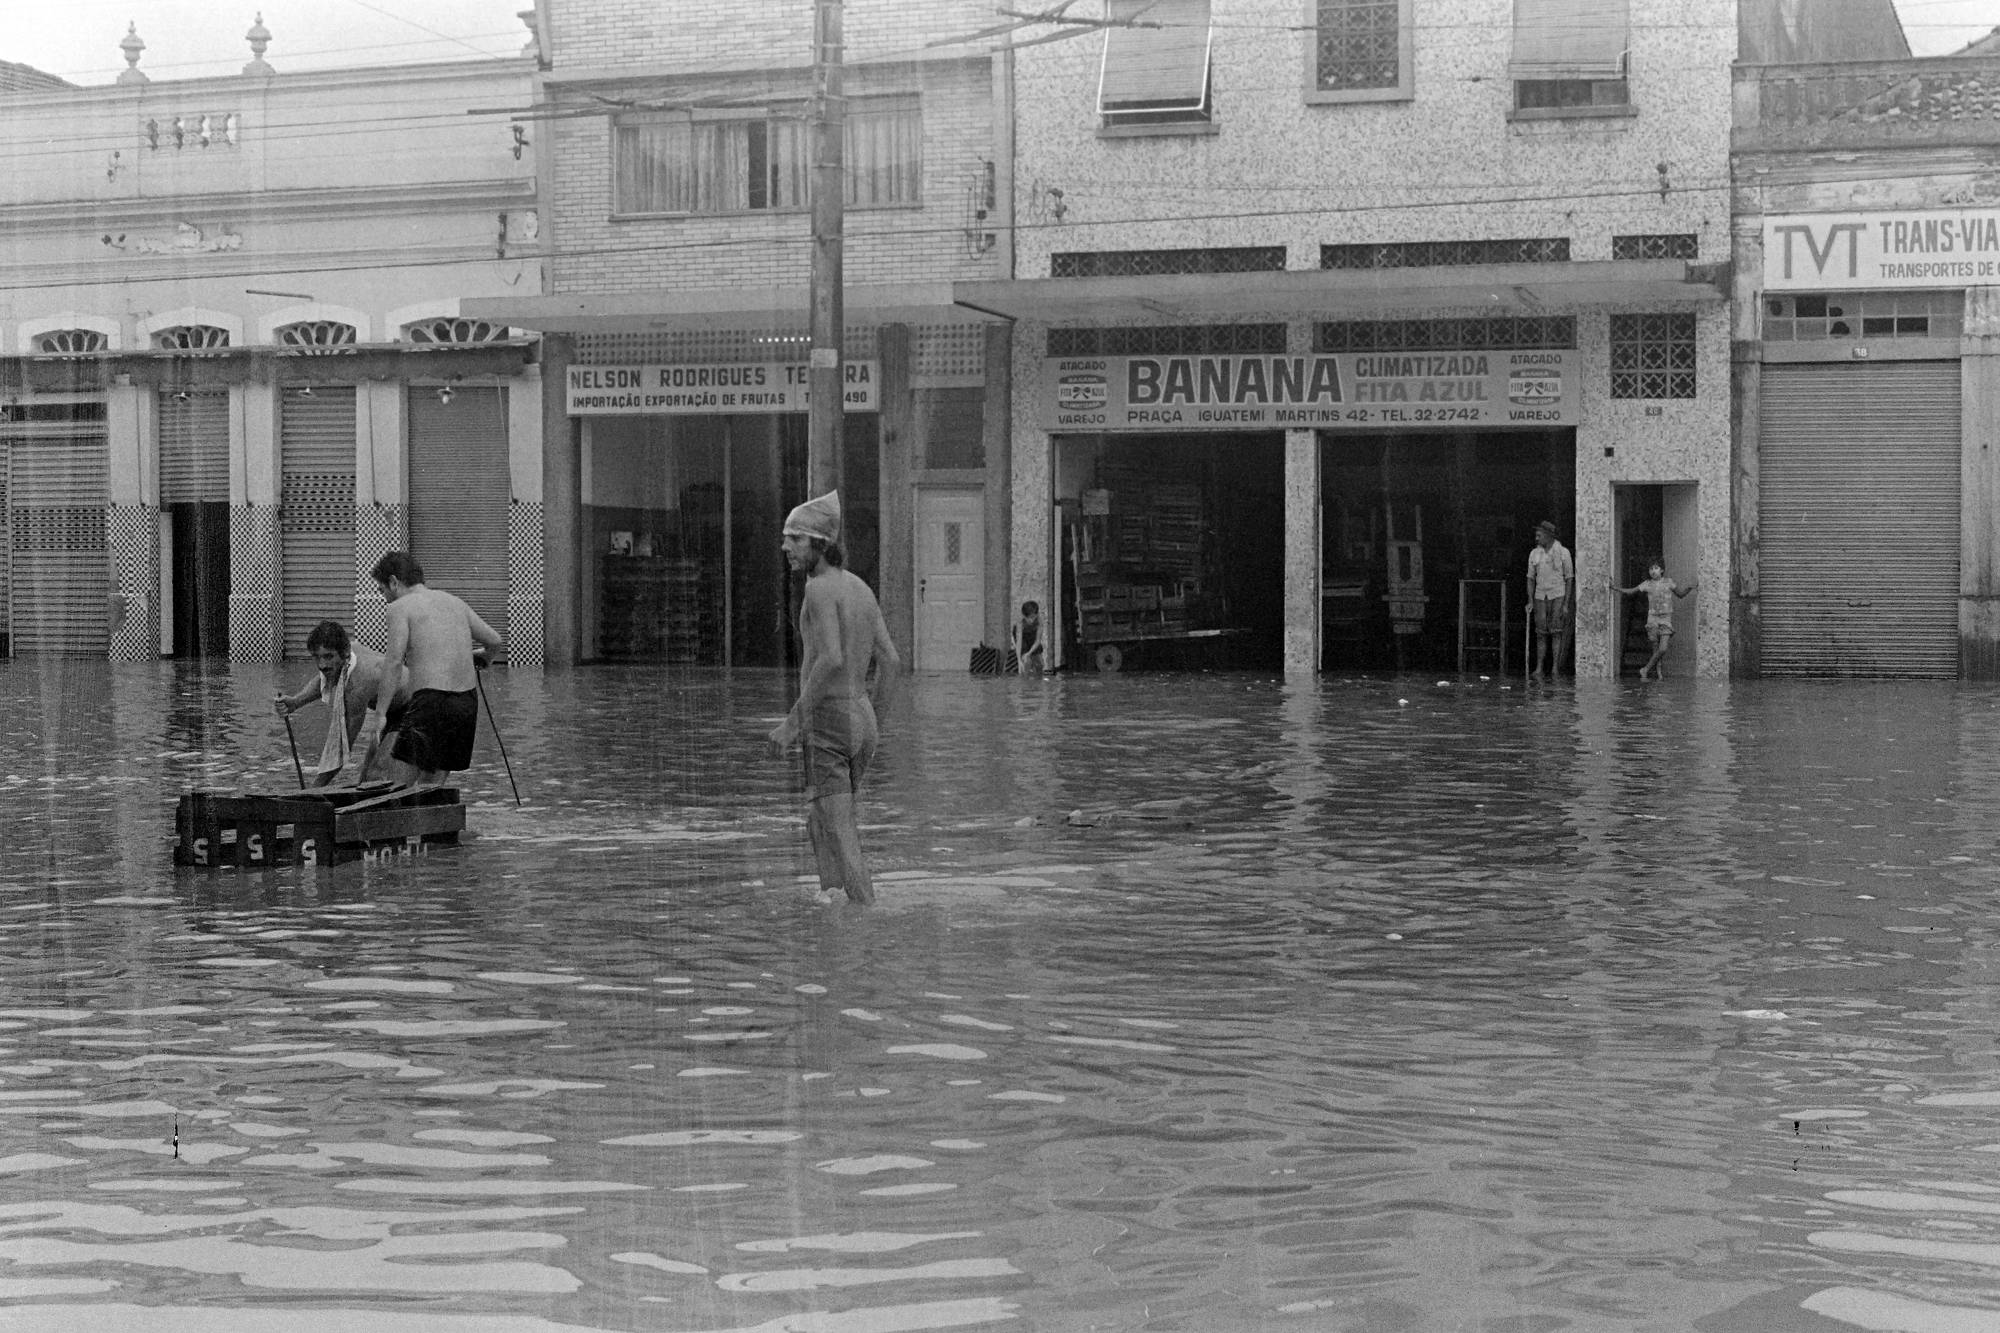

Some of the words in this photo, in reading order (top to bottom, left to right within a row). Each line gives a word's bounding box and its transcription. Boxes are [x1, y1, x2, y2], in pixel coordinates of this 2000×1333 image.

[1774, 223, 1867, 279] TVT
[1880, 262, 1974, 279] TRANSPORTES
[1977, 261, 1994, 277] DE
[1060, 361, 1106, 370] ATACADO
[1355, 356, 1489, 377] CLIMATIZADA
[1510, 354, 1562, 365] ATACADO
[570, 370, 641, 389] NELSON
[660, 367, 766, 387] RODRIGUES
[785, 365, 870, 386] TERA
[1127, 357, 1343, 405] BANANA
[573, 393, 640, 408] IMPORTAÇÃO
[645, 391, 717, 406] EXPORTAÇÃO
[722, 393, 736, 405] DE
[741, 392, 785, 405] FRUTAS
[1355, 381, 1408, 402] FITA
[1419, 381, 1488, 402] AZUL
[1058, 414, 1106, 424] VAREJO
[1128, 410, 1182, 423] PRAÇA
[1198, 410, 1265, 422] IGUATEMI
[1275, 409, 1340, 422] MARTINS
[1509, 410, 1560, 420] VAREJO
